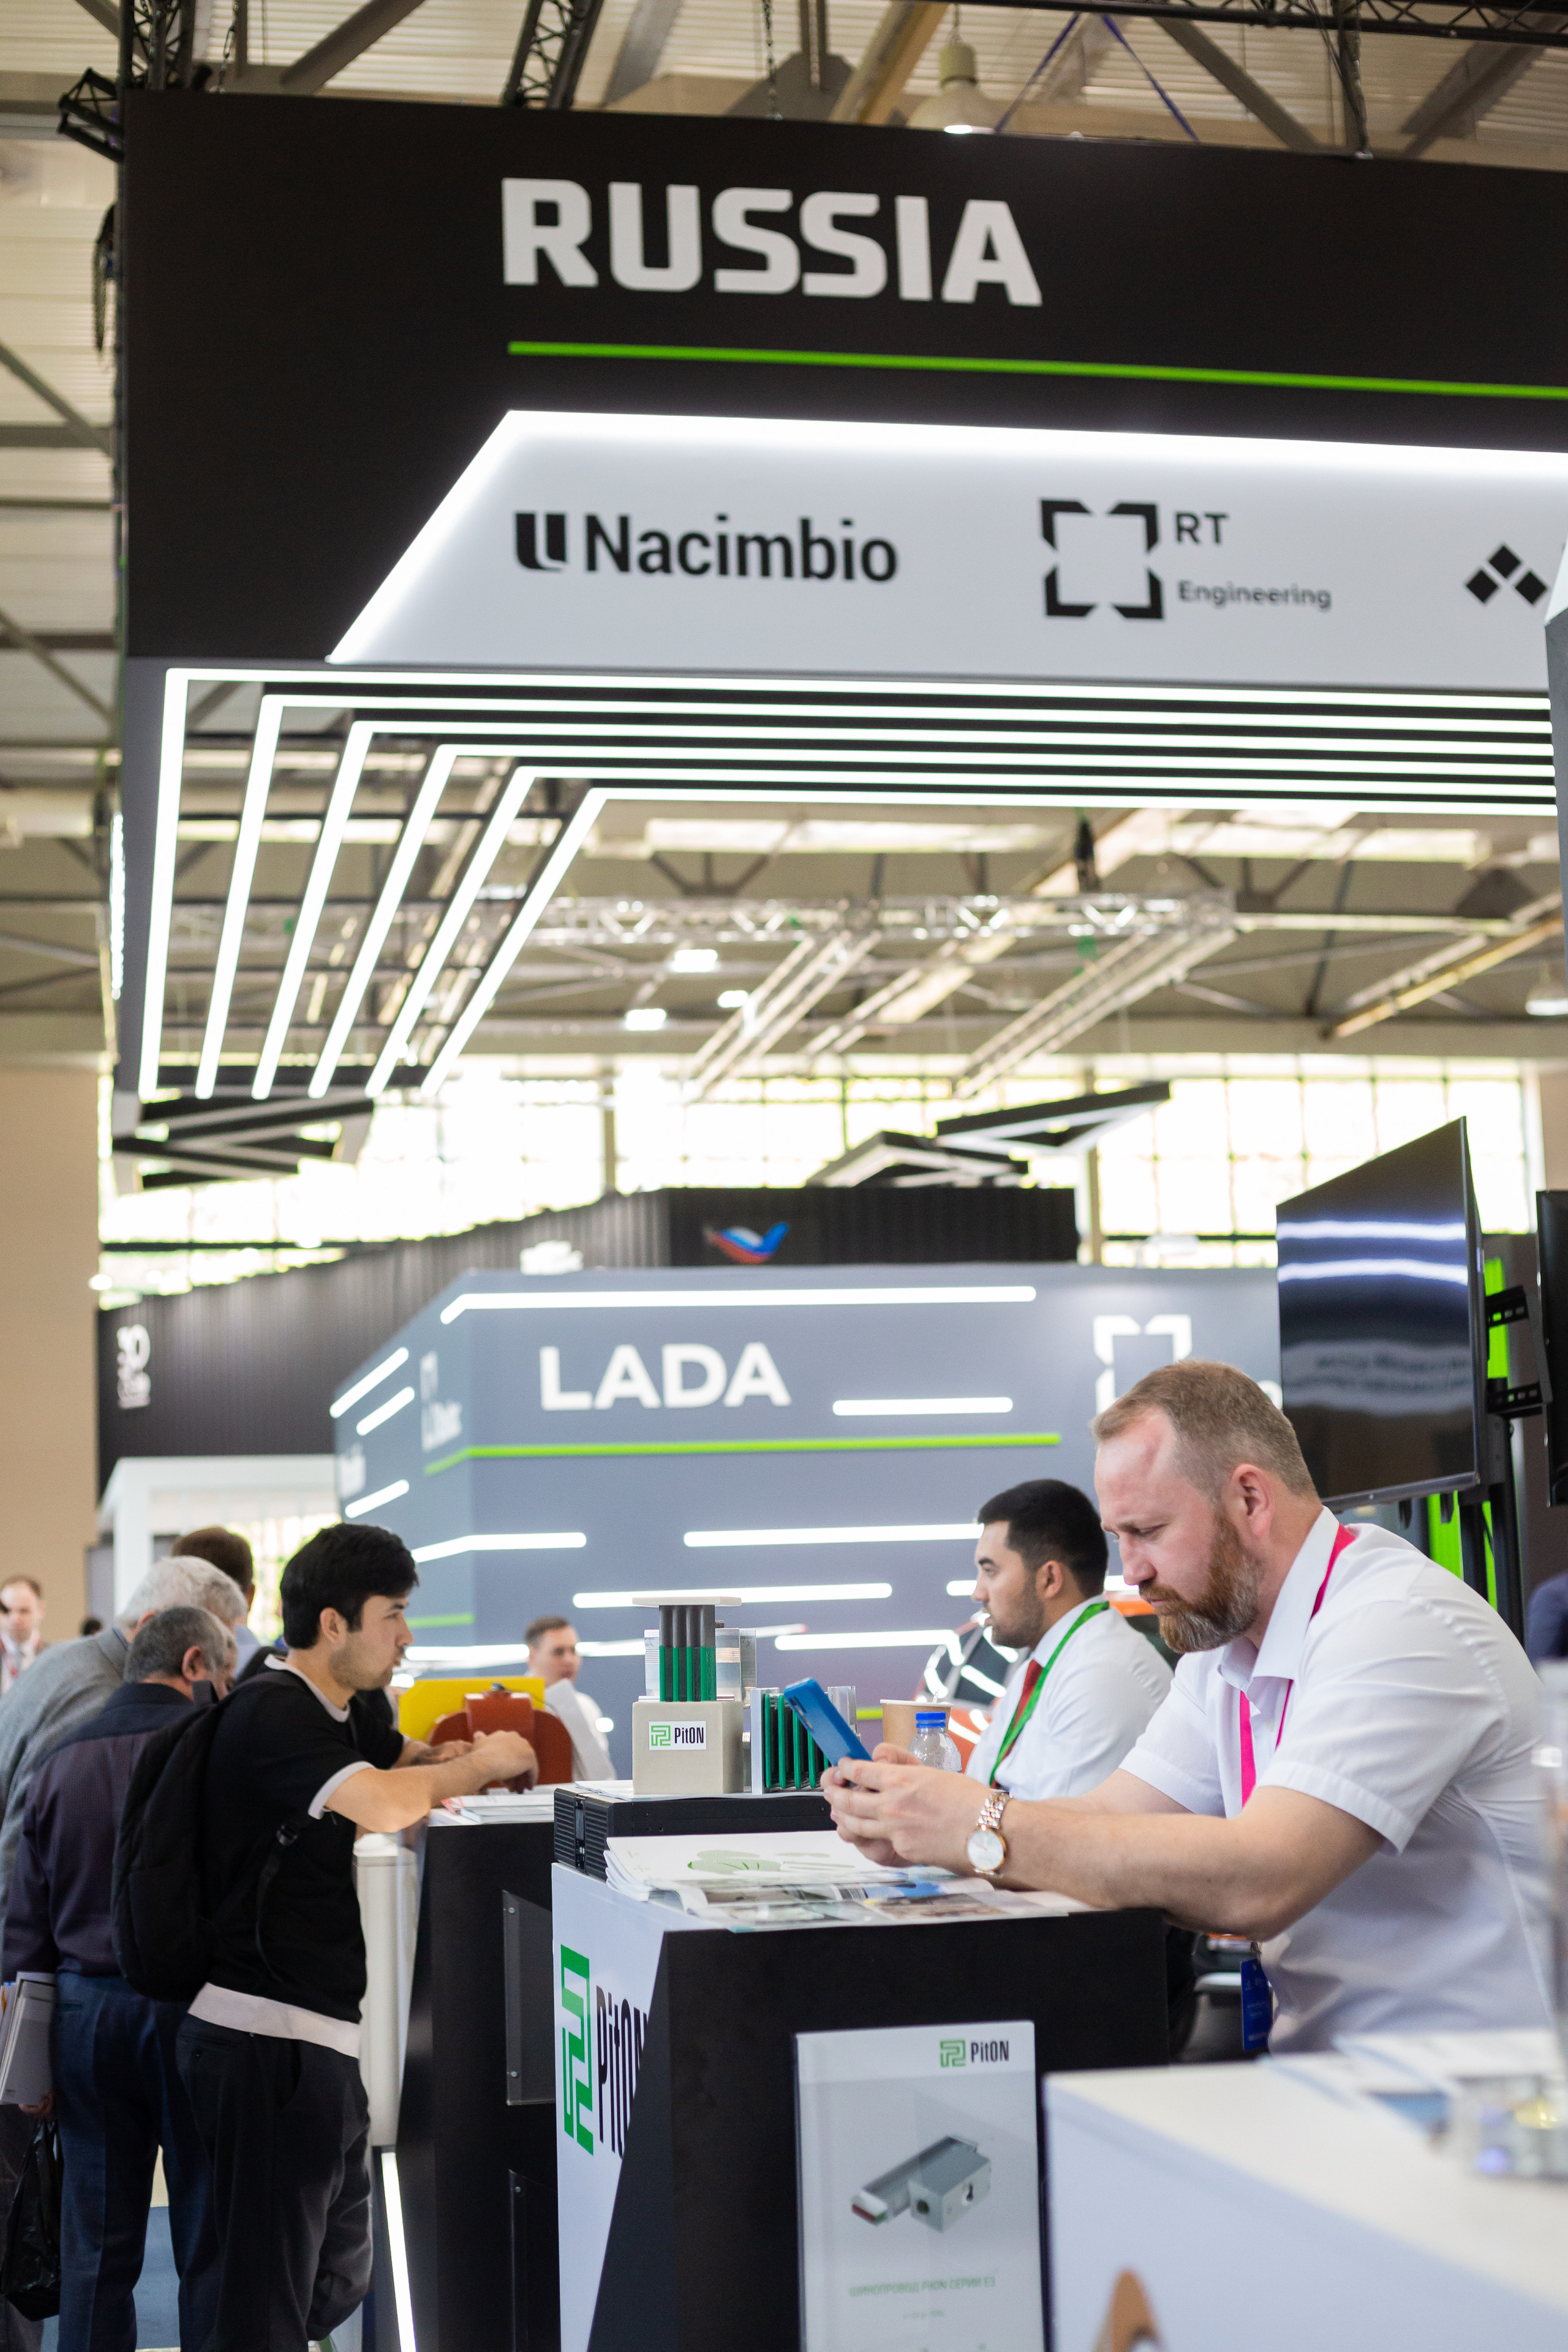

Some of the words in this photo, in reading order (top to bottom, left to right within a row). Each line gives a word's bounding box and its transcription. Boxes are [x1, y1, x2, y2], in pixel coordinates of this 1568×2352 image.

[501, 176, 1043, 307] RUSSIA
[1175, 512, 1230, 545] RT
[584, 512, 899, 581] Nacimbio
[1178, 580, 1332, 611] Engineering
[539, 1342, 791, 1411] LADA
[674, 1727, 704, 1744] PitON
[971, 2040, 1009, 2063] PitON
